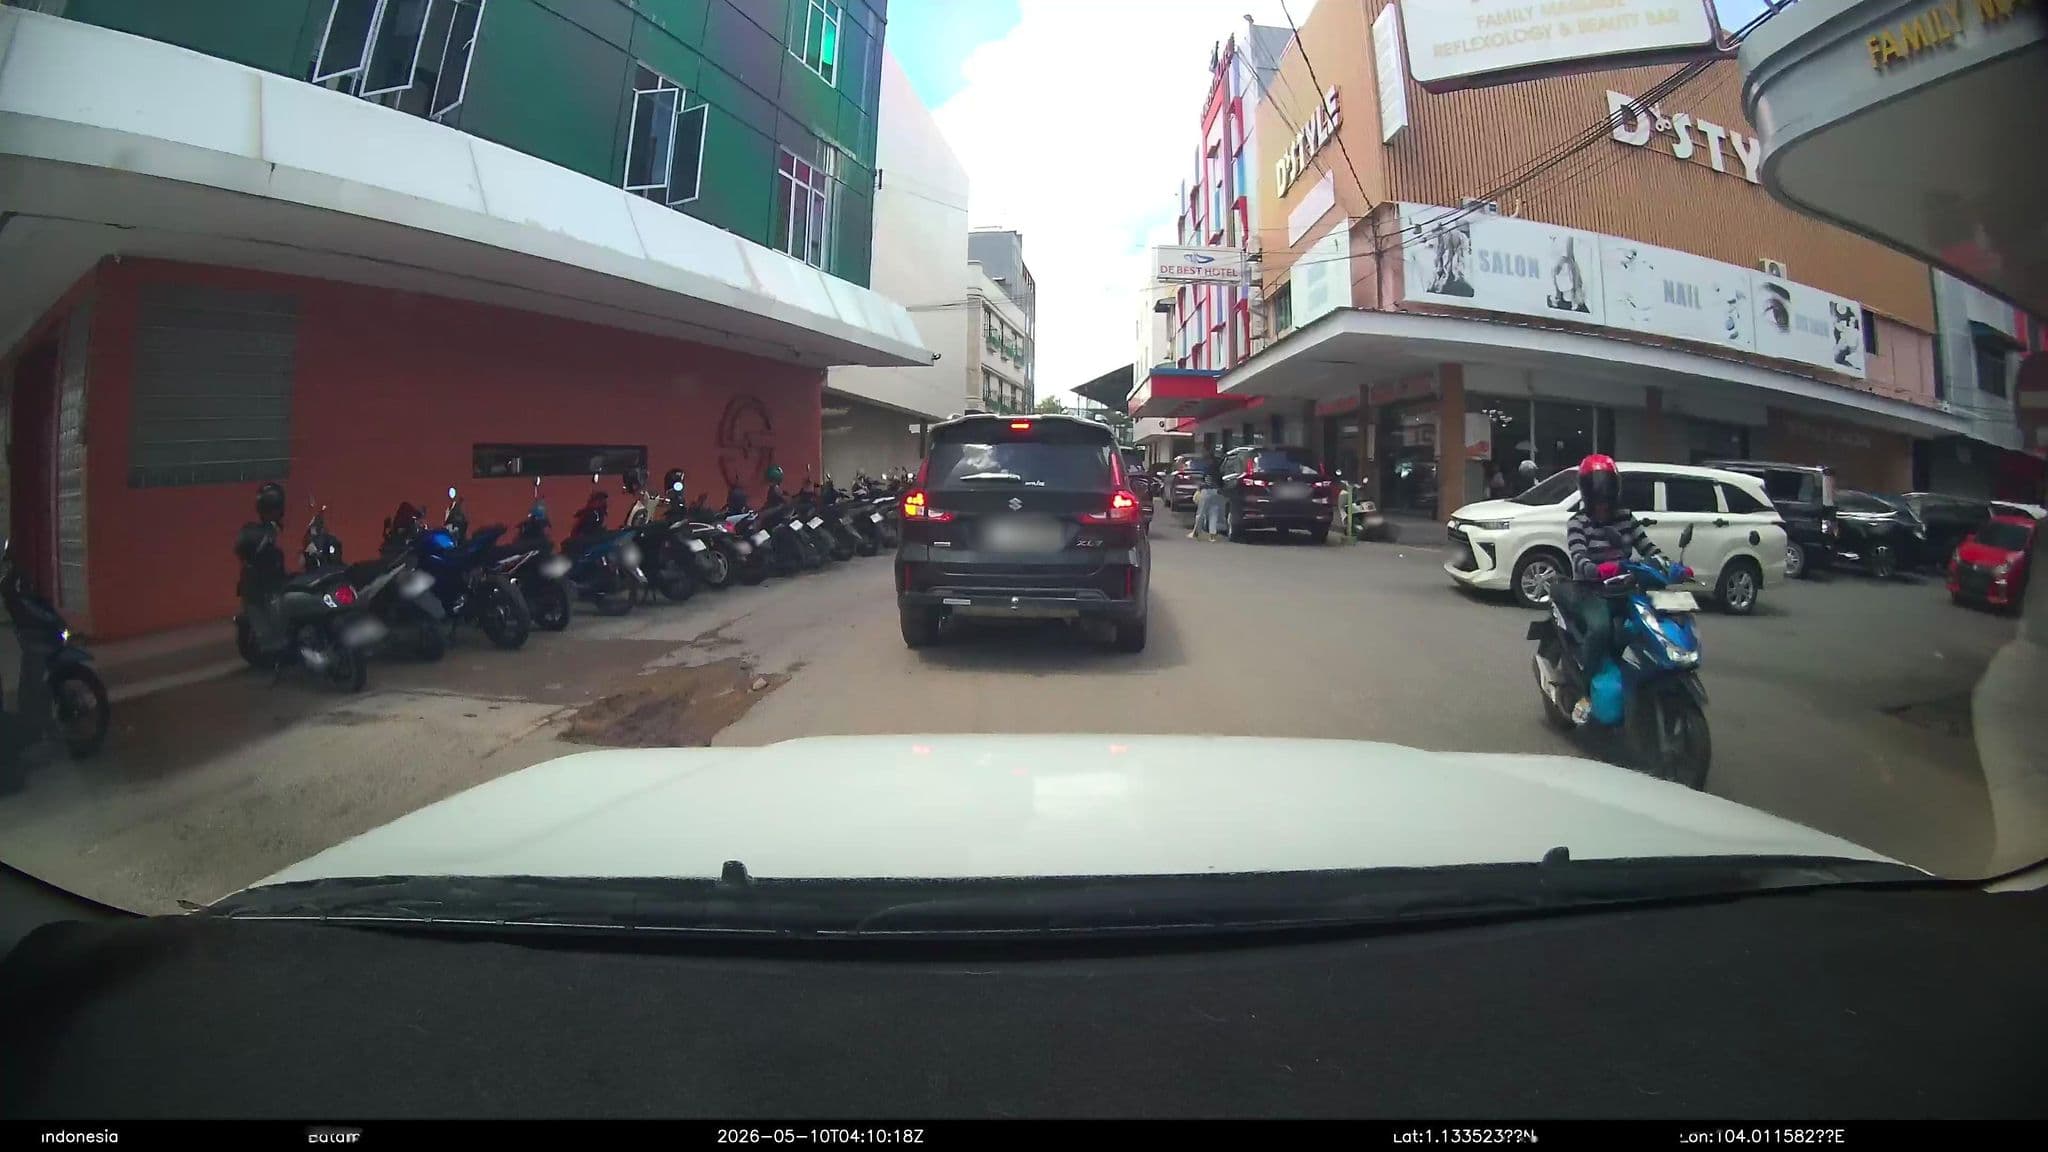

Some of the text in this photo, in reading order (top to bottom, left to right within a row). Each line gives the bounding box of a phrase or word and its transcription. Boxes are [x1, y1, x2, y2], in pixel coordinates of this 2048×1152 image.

[1476, 6, 1533, 29] FAMILY
[1432, 22, 1552, 57] REFLEXOLOGY
[1866, 0, 1964, 70] FAMILY
[1160, 265, 1238, 277] DE BEST HOTEL
[1479, 249, 1540, 280] SALON
[1663, 279, 1701, 309] NAIL
